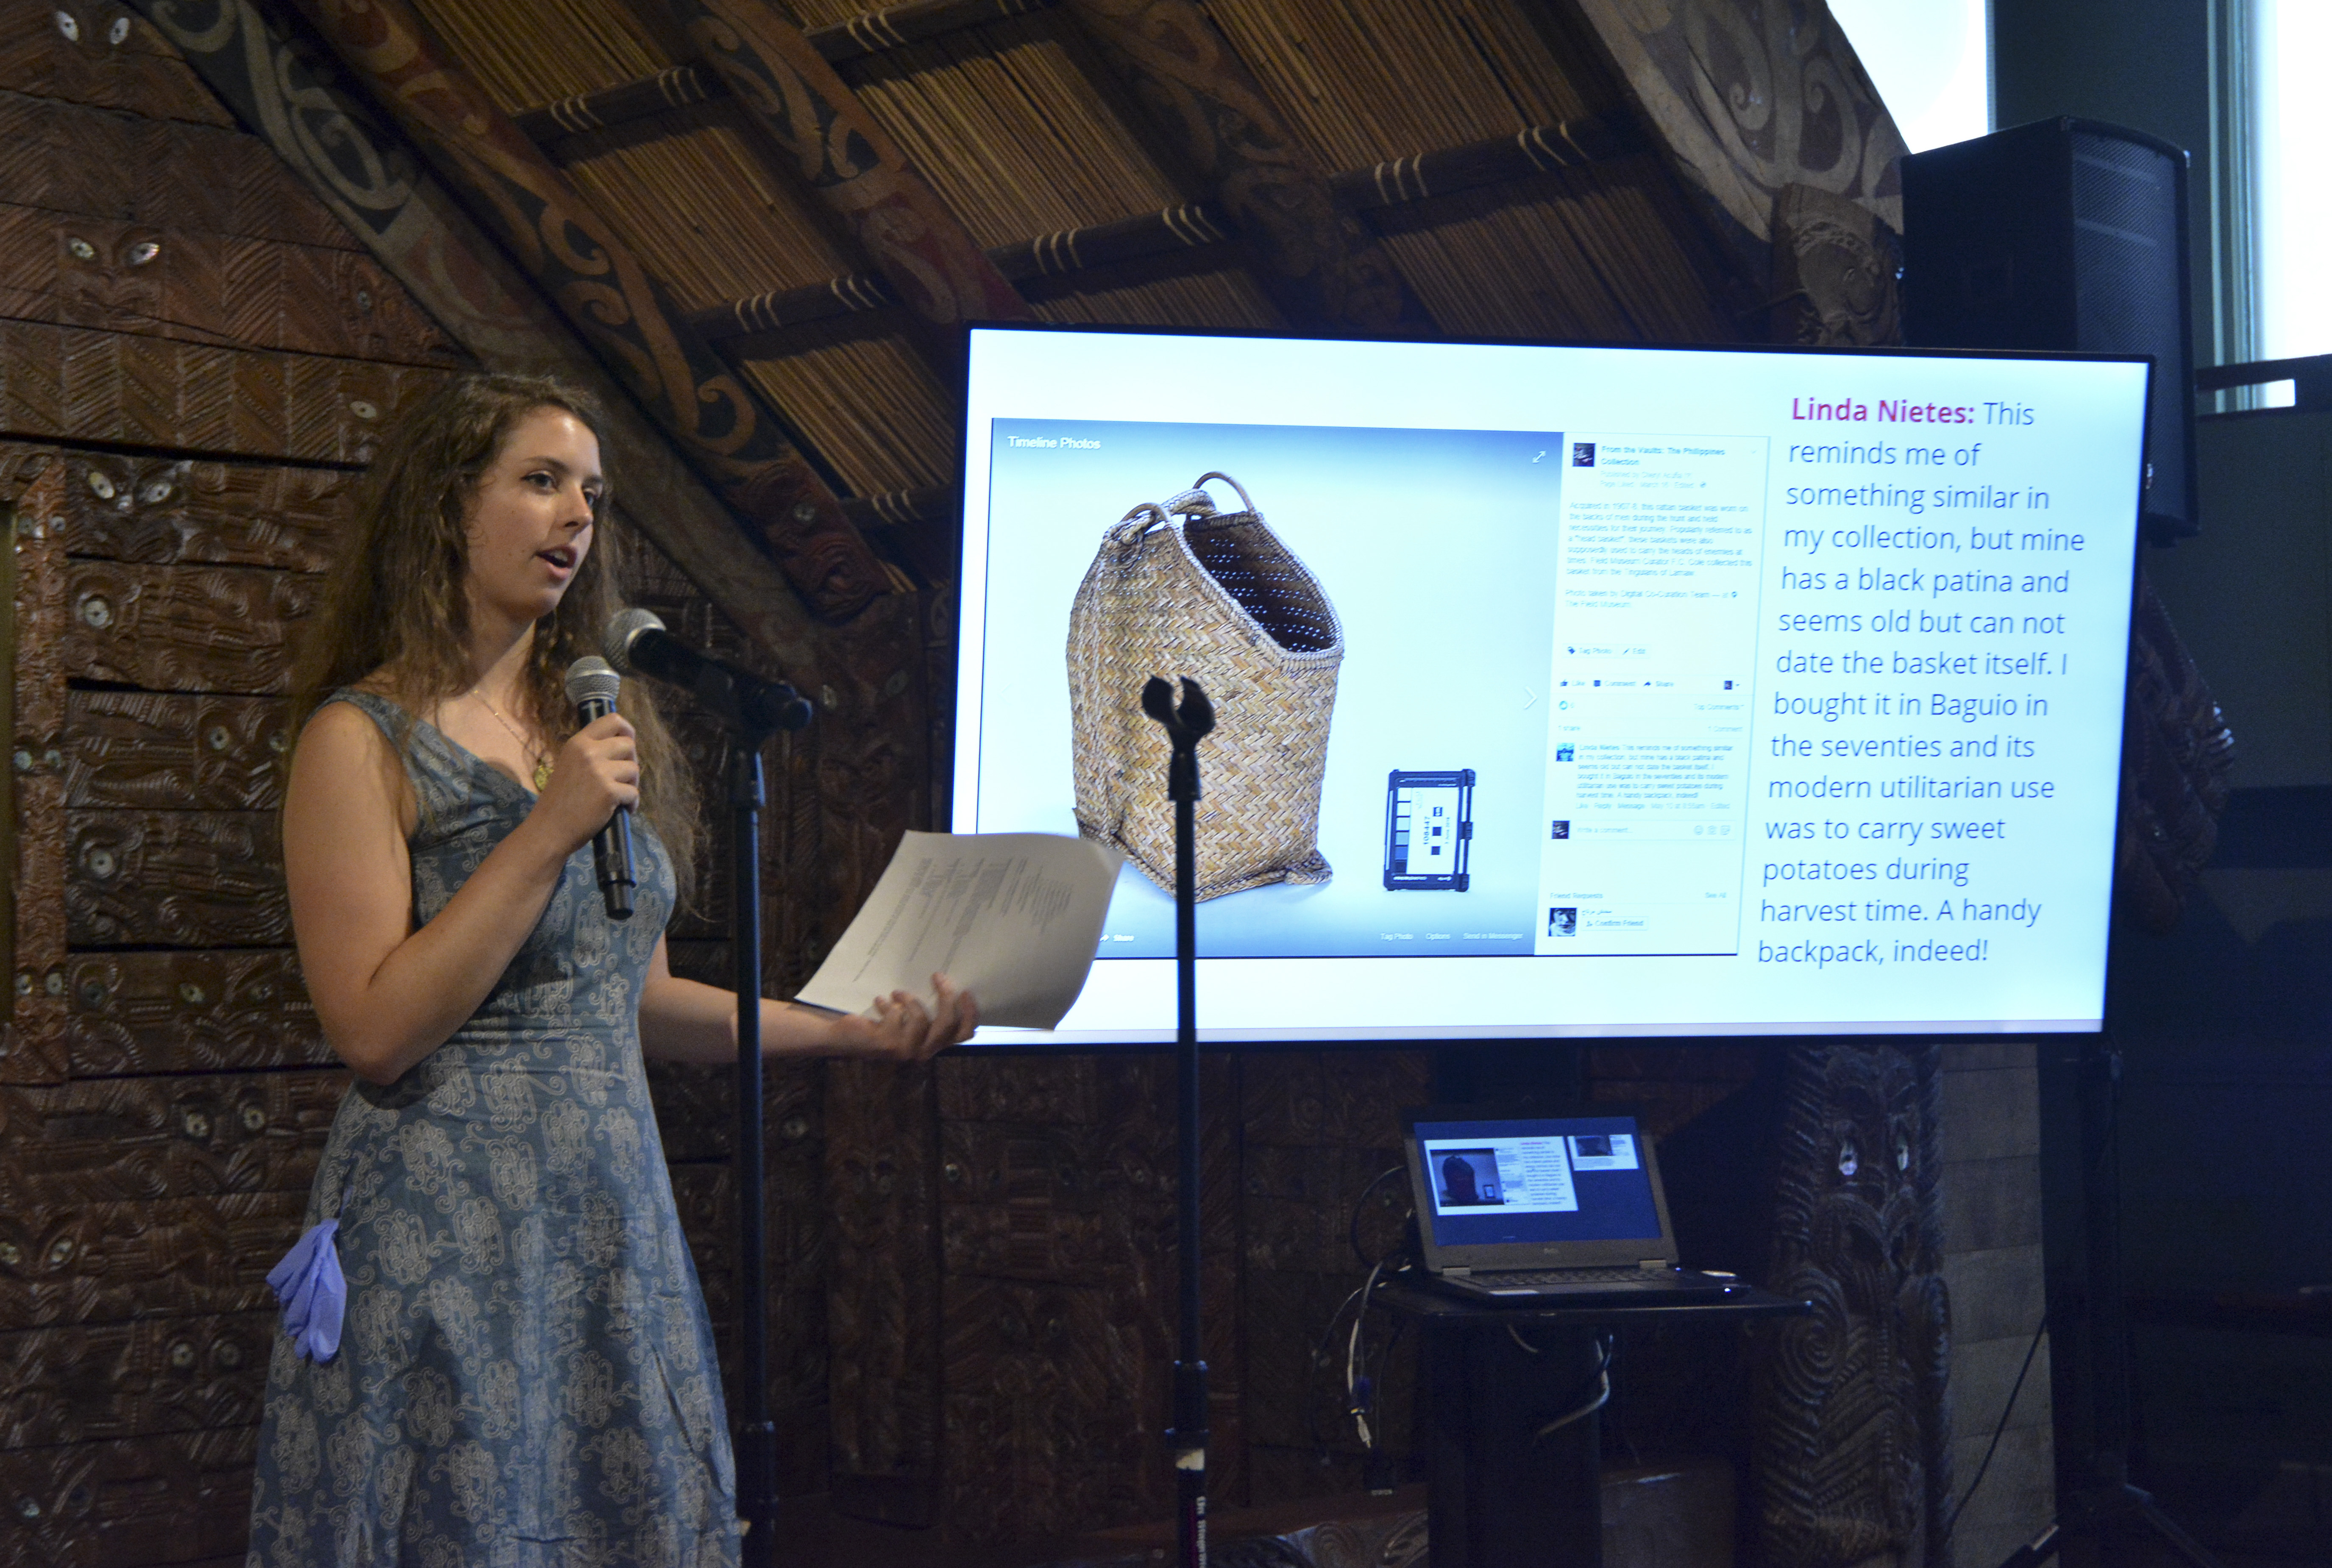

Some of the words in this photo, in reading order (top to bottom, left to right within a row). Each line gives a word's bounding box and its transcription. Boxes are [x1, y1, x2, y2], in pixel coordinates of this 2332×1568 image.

[1792, 397, 1867, 422] Linda
[1878, 399, 1974, 424] Nietes:
[1982, 401, 2034, 425] This
[1007, 436, 1057, 448] Timeline
[1060, 437, 1101, 449] Photos
[1684, 448, 1725, 456] Philippines
[1789, 441, 1896, 464] reminds
[1905, 448, 1945, 465] me
[1954, 443, 1982, 466] of
[1787, 482, 1926, 514] something
[1932, 484, 2020, 509] similar
[2027, 486, 2049, 509] in
[1784, 530, 1825, 555] my
[1831, 524, 1961, 553] collection,
[1970, 526, 2013, 550] but
[2021, 528, 2084, 551] mine
[1781, 566, 1826, 590] has
[1835, 573, 1848, 590] a
[1859, 567, 1925, 591] black
[1933, 570, 2012, 599] patina
[2021, 570, 2069, 593] and
[1778, 614, 1862, 632] seems
[1871, 609, 1910, 632] old
[1919, 609, 1962, 633] but
[1970, 616, 2014, 634] can
[2023, 614, 2066, 634] not
[1776, 650, 1834, 673] date
[1842, 651, 1884, 673] the
[1892, 651, 1978, 674] basket
[1985, 652, 2051, 675] itself.
[2062, 653, 2067, 675] I
[1774, 691, 1867, 722] bought
[1875, 692, 1891, 715] it
[1899, 692, 1921, 715] in
[1931, 693, 2018, 723] Baguio
[2026, 693, 2048, 716] in
[1770, 734, 1812, 756] the
[1820, 735, 1941, 757] seventies
[1950, 734, 1998, 757] and
[2006, 735, 2034, 757] its
[1769, 775, 1871, 798] modern
[1881, 775, 2001, 798] utilitarian
[2011, 781, 2054, 798] use
[1765, 822, 1815, 839] was
[1823, 819, 1849, 839] to
[1858, 822, 1923, 846] carry
[1930, 819, 2006, 839] sweet
[1763, 860, 1877, 887] potatoes
[1886, 857, 1970, 887] during
[1761, 899, 1857, 922] harvest
[1864, 899, 1928, 921] time.
[1936, 899, 1954, 921] A
[1962, 898, 2042, 928] handy
[1758, 939, 1884, 970] backpack,
[1894, 938, 1987, 962] indeed!
